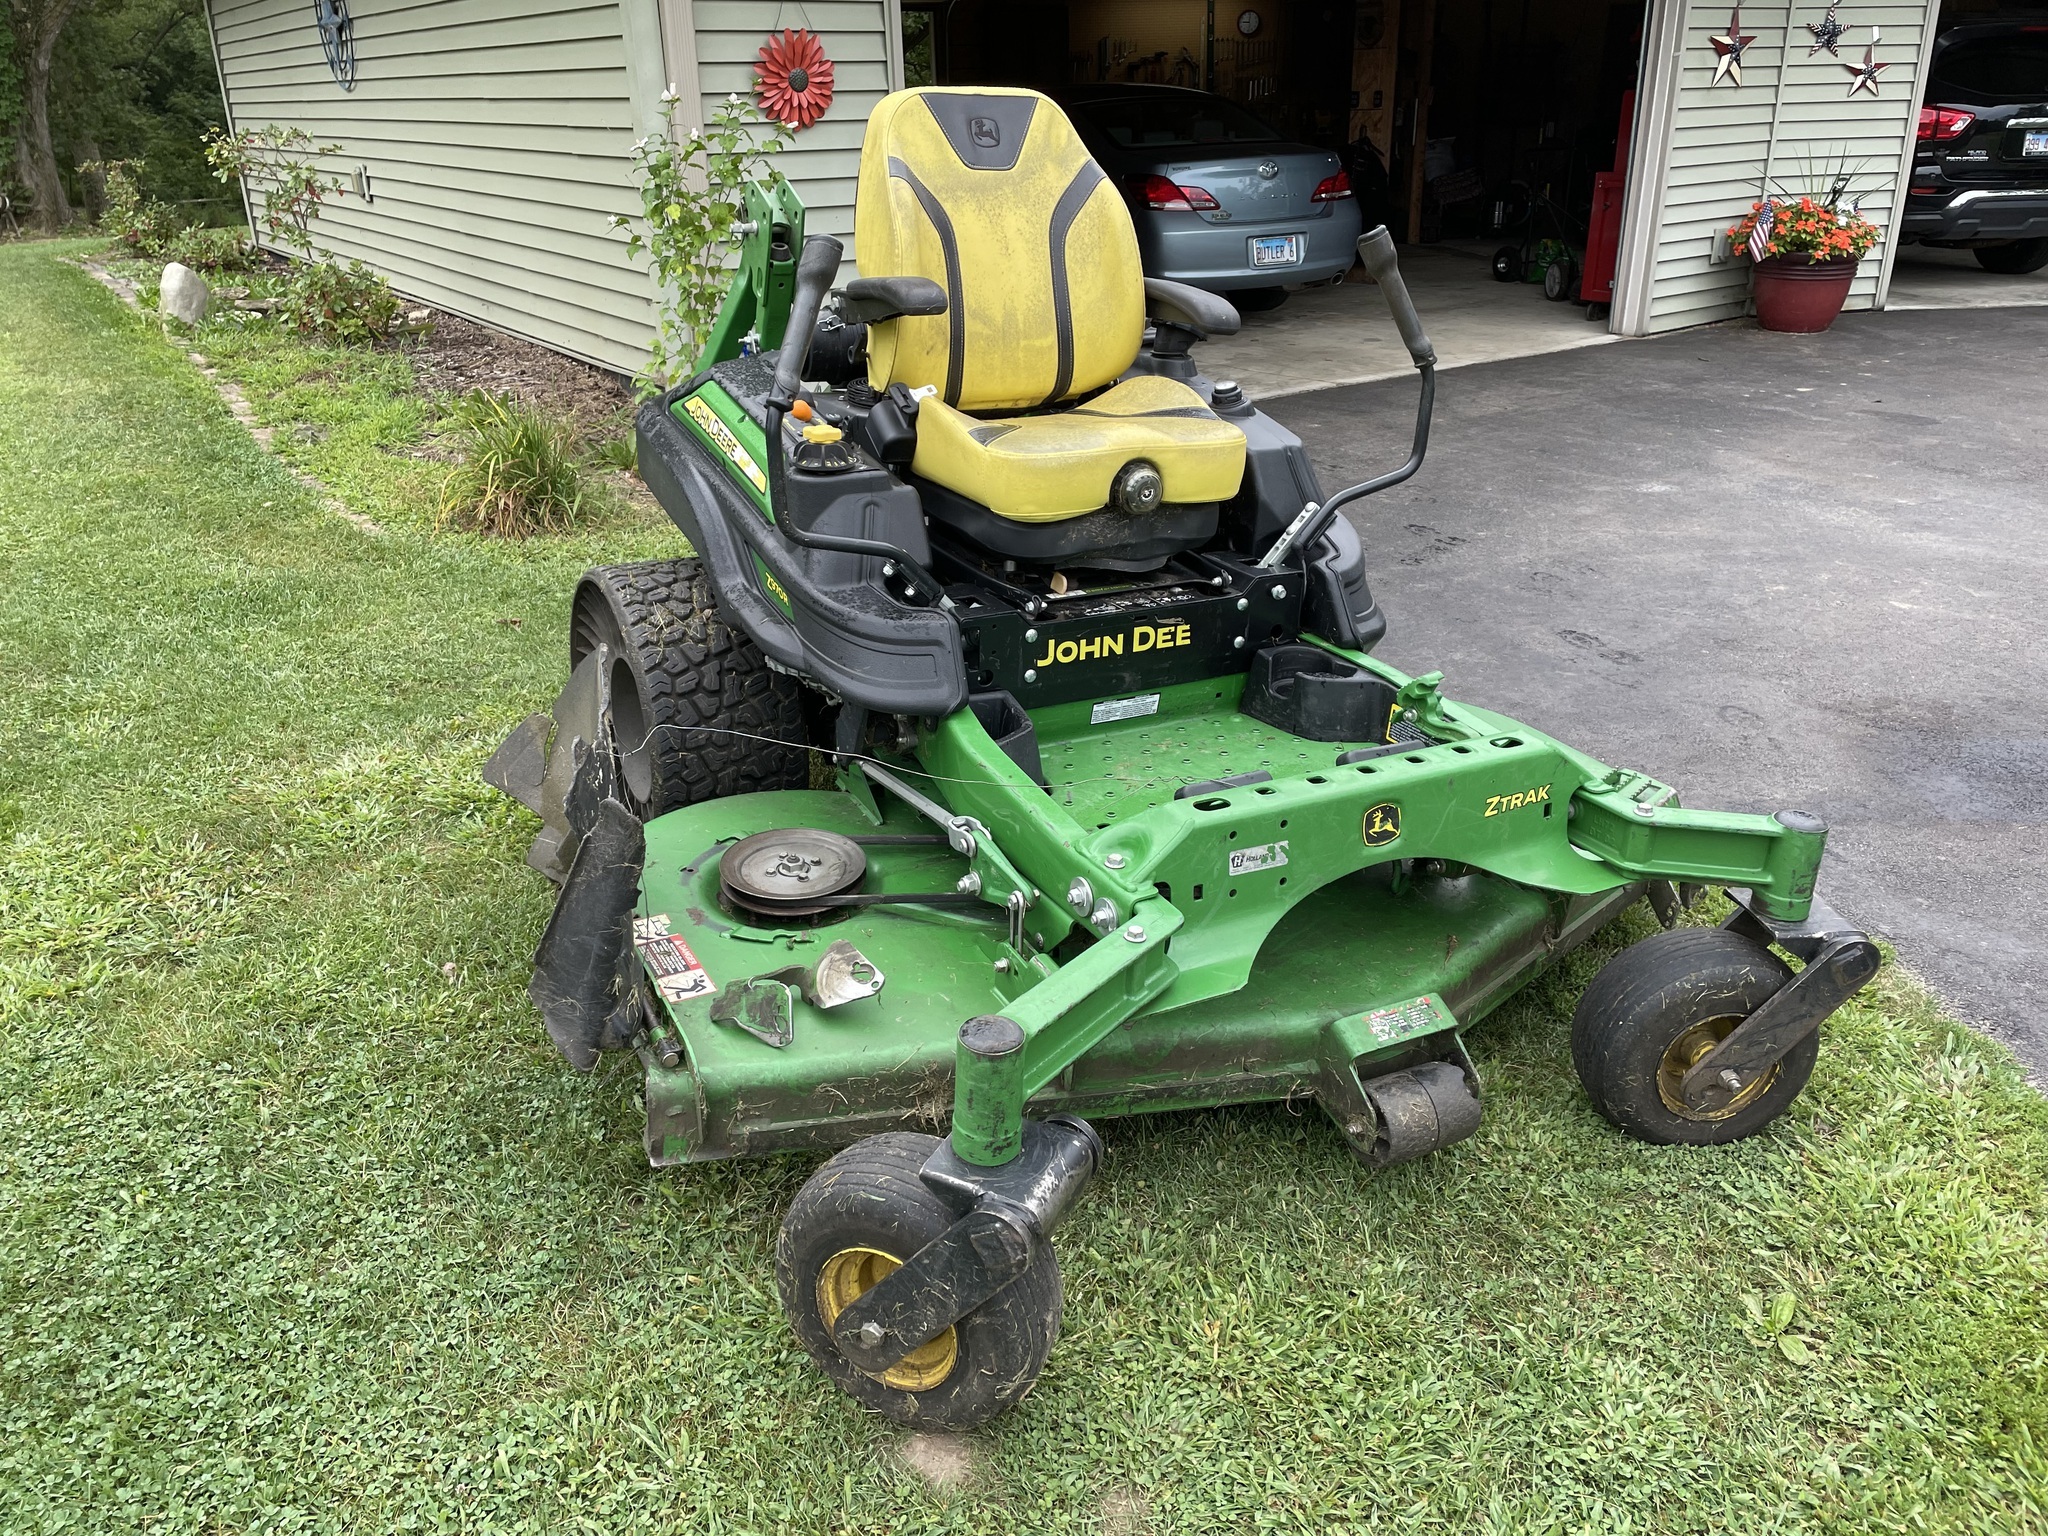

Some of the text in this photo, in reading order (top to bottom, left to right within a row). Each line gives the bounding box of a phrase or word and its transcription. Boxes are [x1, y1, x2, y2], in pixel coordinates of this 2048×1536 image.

[1256, 245, 1285, 260] BUTLER
[691, 400, 738, 458] JOHN DEERE
[1036, 624, 1191, 667] JOHN DEE
[1484, 783, 1552, 817] ZTRAK
[680, 944, 698, 966] DANGER
